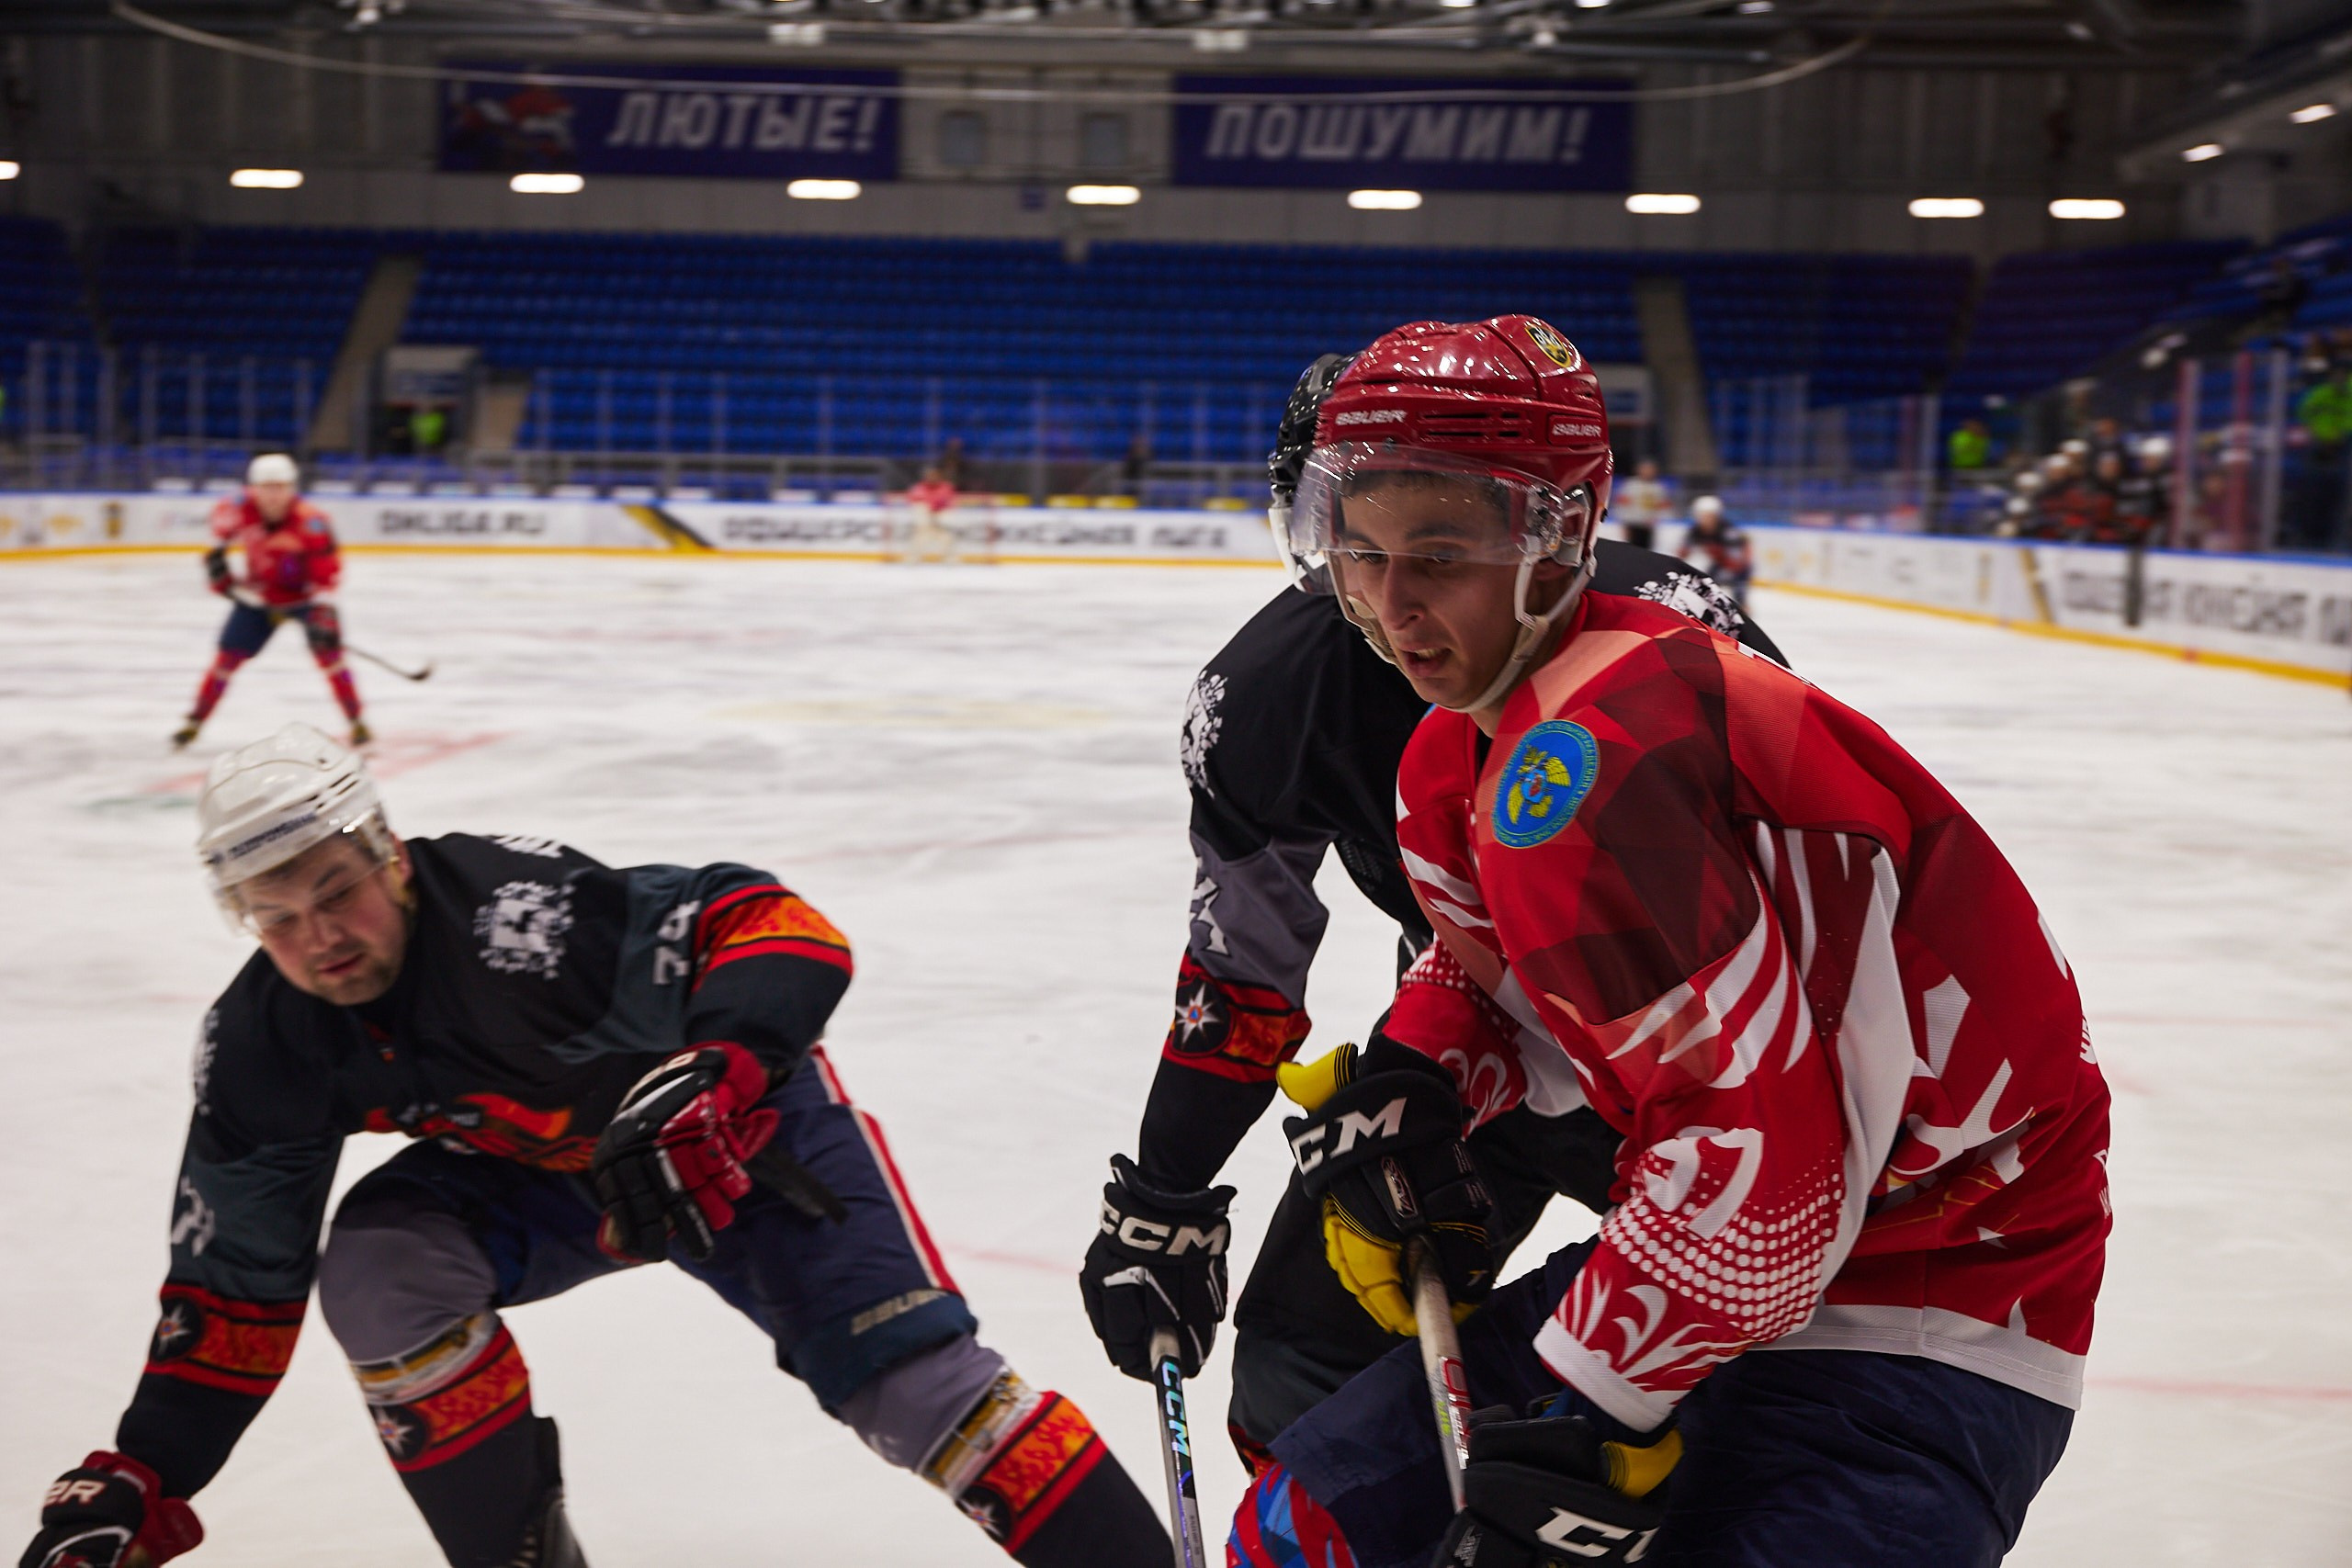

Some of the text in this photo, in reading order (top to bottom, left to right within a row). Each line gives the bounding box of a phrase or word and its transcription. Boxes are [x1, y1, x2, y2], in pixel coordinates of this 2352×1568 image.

[607, 93, 881, 151] ЛЮТЫЕ!
[1206, 105, 1589, 163] ПОШУМИМ!
[1101, 1199, 1229, 1257] CCM
[1161, 1360, 1191, 1458] CCM
